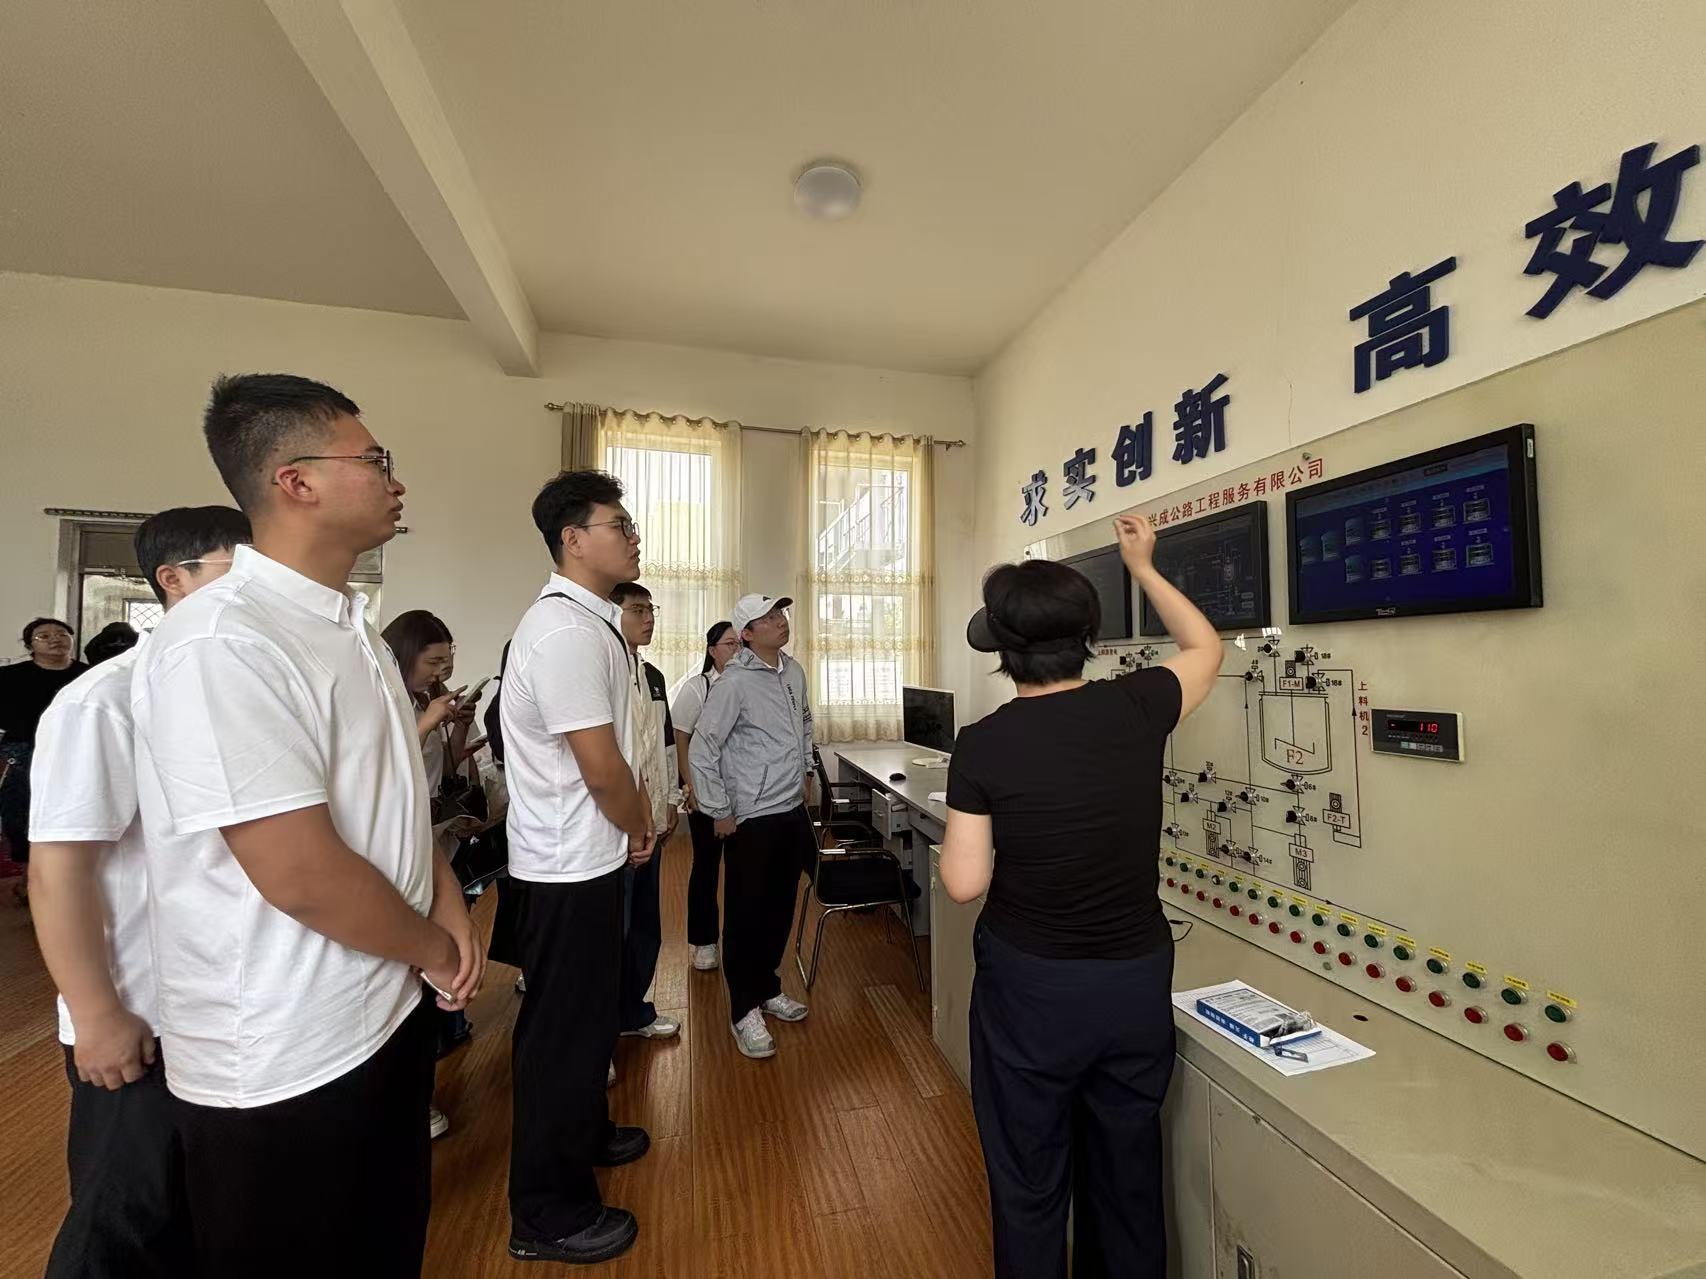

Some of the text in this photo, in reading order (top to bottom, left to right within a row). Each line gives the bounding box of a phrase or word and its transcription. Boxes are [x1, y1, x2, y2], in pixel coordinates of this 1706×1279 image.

[1020, 142, 1705, 527] 求实创新 高效
[1282, 678, 1301, 688] F1-M
[1286, 748, 1304, 765] F2
[1295, 847, 1308, 858] M3
